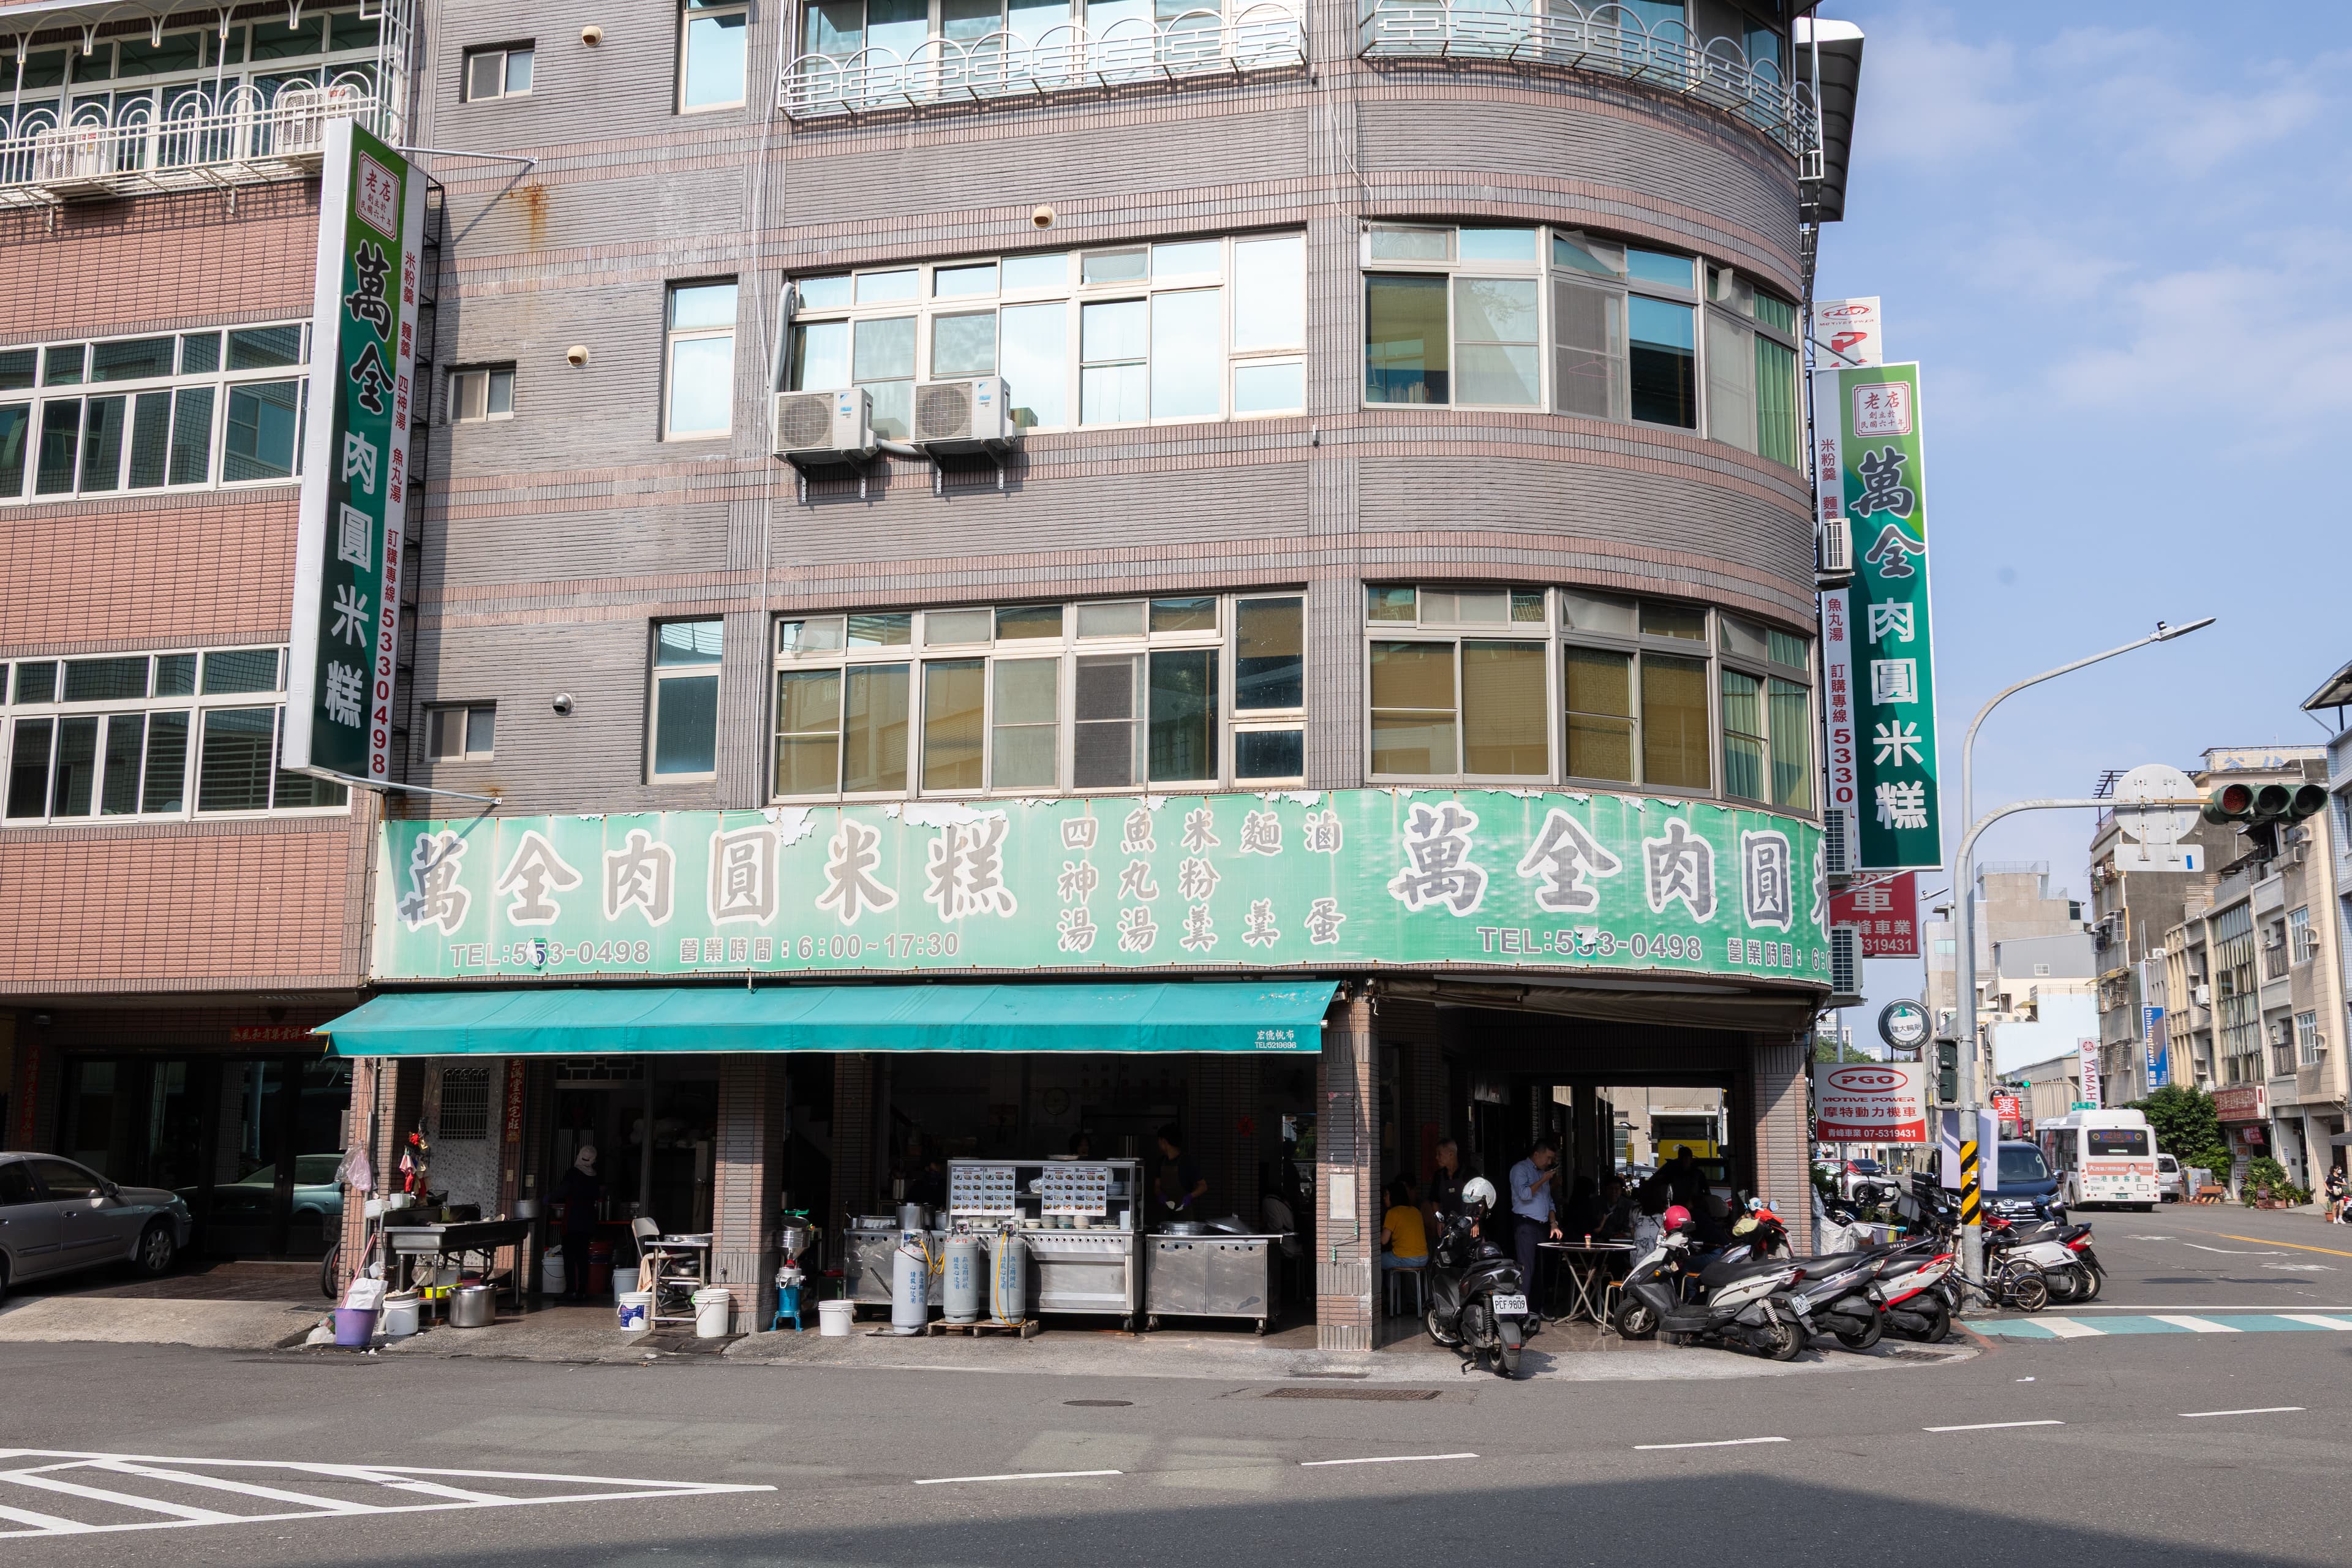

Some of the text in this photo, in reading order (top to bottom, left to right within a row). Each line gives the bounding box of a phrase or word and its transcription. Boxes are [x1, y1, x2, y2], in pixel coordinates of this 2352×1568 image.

[366, 168, 391, 203] 老店
[368, 193, 387, 213] 創立於
[361, 199, 393, 228] 民國六十年
[403, 251, 417, 307] 米粉羹
[399, 322, 413, 360] 麵羹
[396, 375, 409, 431] 四神湯
[1864, 391, 1899, 410] 老店
[1869, 410, 1895, 419] 創立於
[1861, 418, 1904, 428] 民國六十年
[390, 447, 404, 504] 魚丸湯
[1821, 439, 1837, 481] 米粉羹
[1827, 598, 1844, 642] 魚丸湯
[398, 813, 1017, 935] 萬全肉圓米糕
[1057, 816, 1098, 952] 四神湯
[1117, 809, 1159, 953] 魚丸湯
[1179, 807, 1221, 952] 米粉羹
[2145, 1009, 2157, 1066] thinkingtravel
[1841, 1076, 1894, 1084] PGO
[2084, 1059, 2097, 1100] YAMAH
[1824, 1107, 1917, 1117] 摩特動力機車
[1828, 1129, 1861, 1137] 青峰車業
